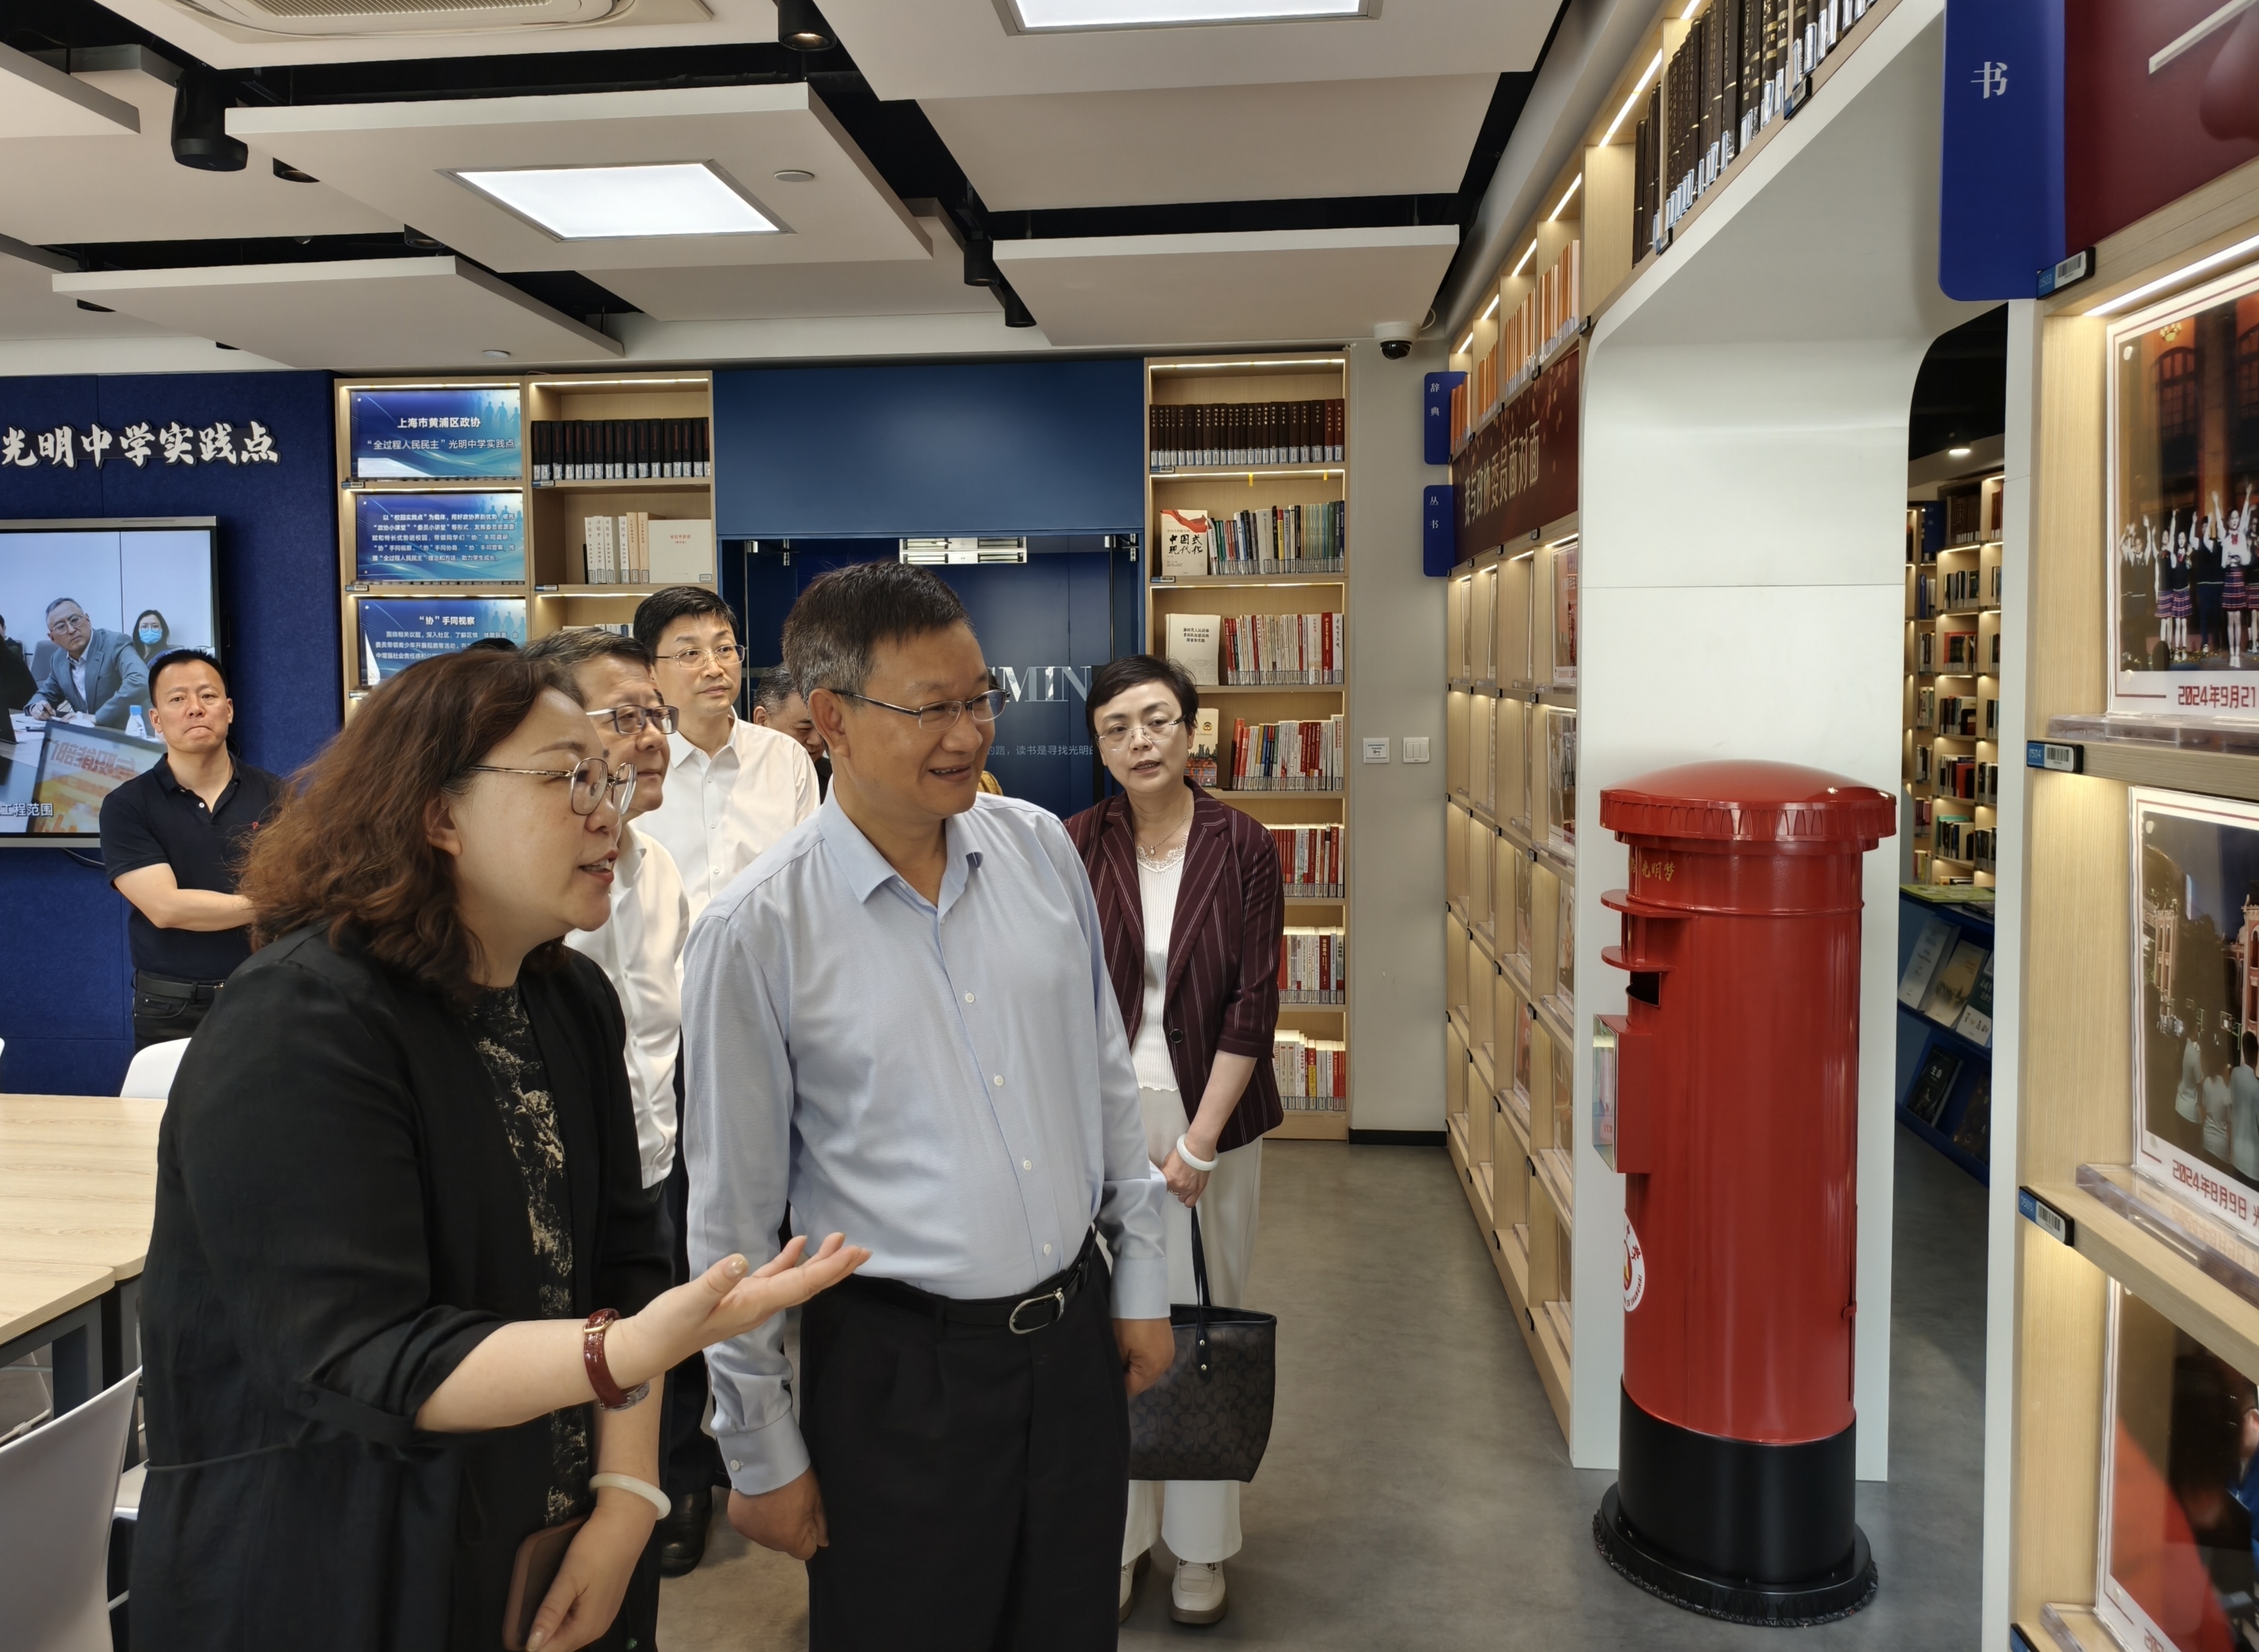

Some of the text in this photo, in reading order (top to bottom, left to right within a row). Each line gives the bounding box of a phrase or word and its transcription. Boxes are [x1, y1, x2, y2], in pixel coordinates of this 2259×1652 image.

[1970, 62, 2007, 99] 书
[397, 417, 481, 429] 上海市黄浦区政协
[2, 421, 278, 468] 光明中学实践点
[1168, 545, 1203, 555] 现代化
[1170, 534, 1202, 545] 中国式
[419, 616, 475, 625] “协”手同视察
[988, 666, 1091, 702] MIN
[2178, 684, 2259, 709] 2024年9月21
[0, 803, 53, 816] 工程范围
[1630, 857, 1676, 882] 光明梦
[2172, 1159, 2247, 1220] 2024年8月9日
